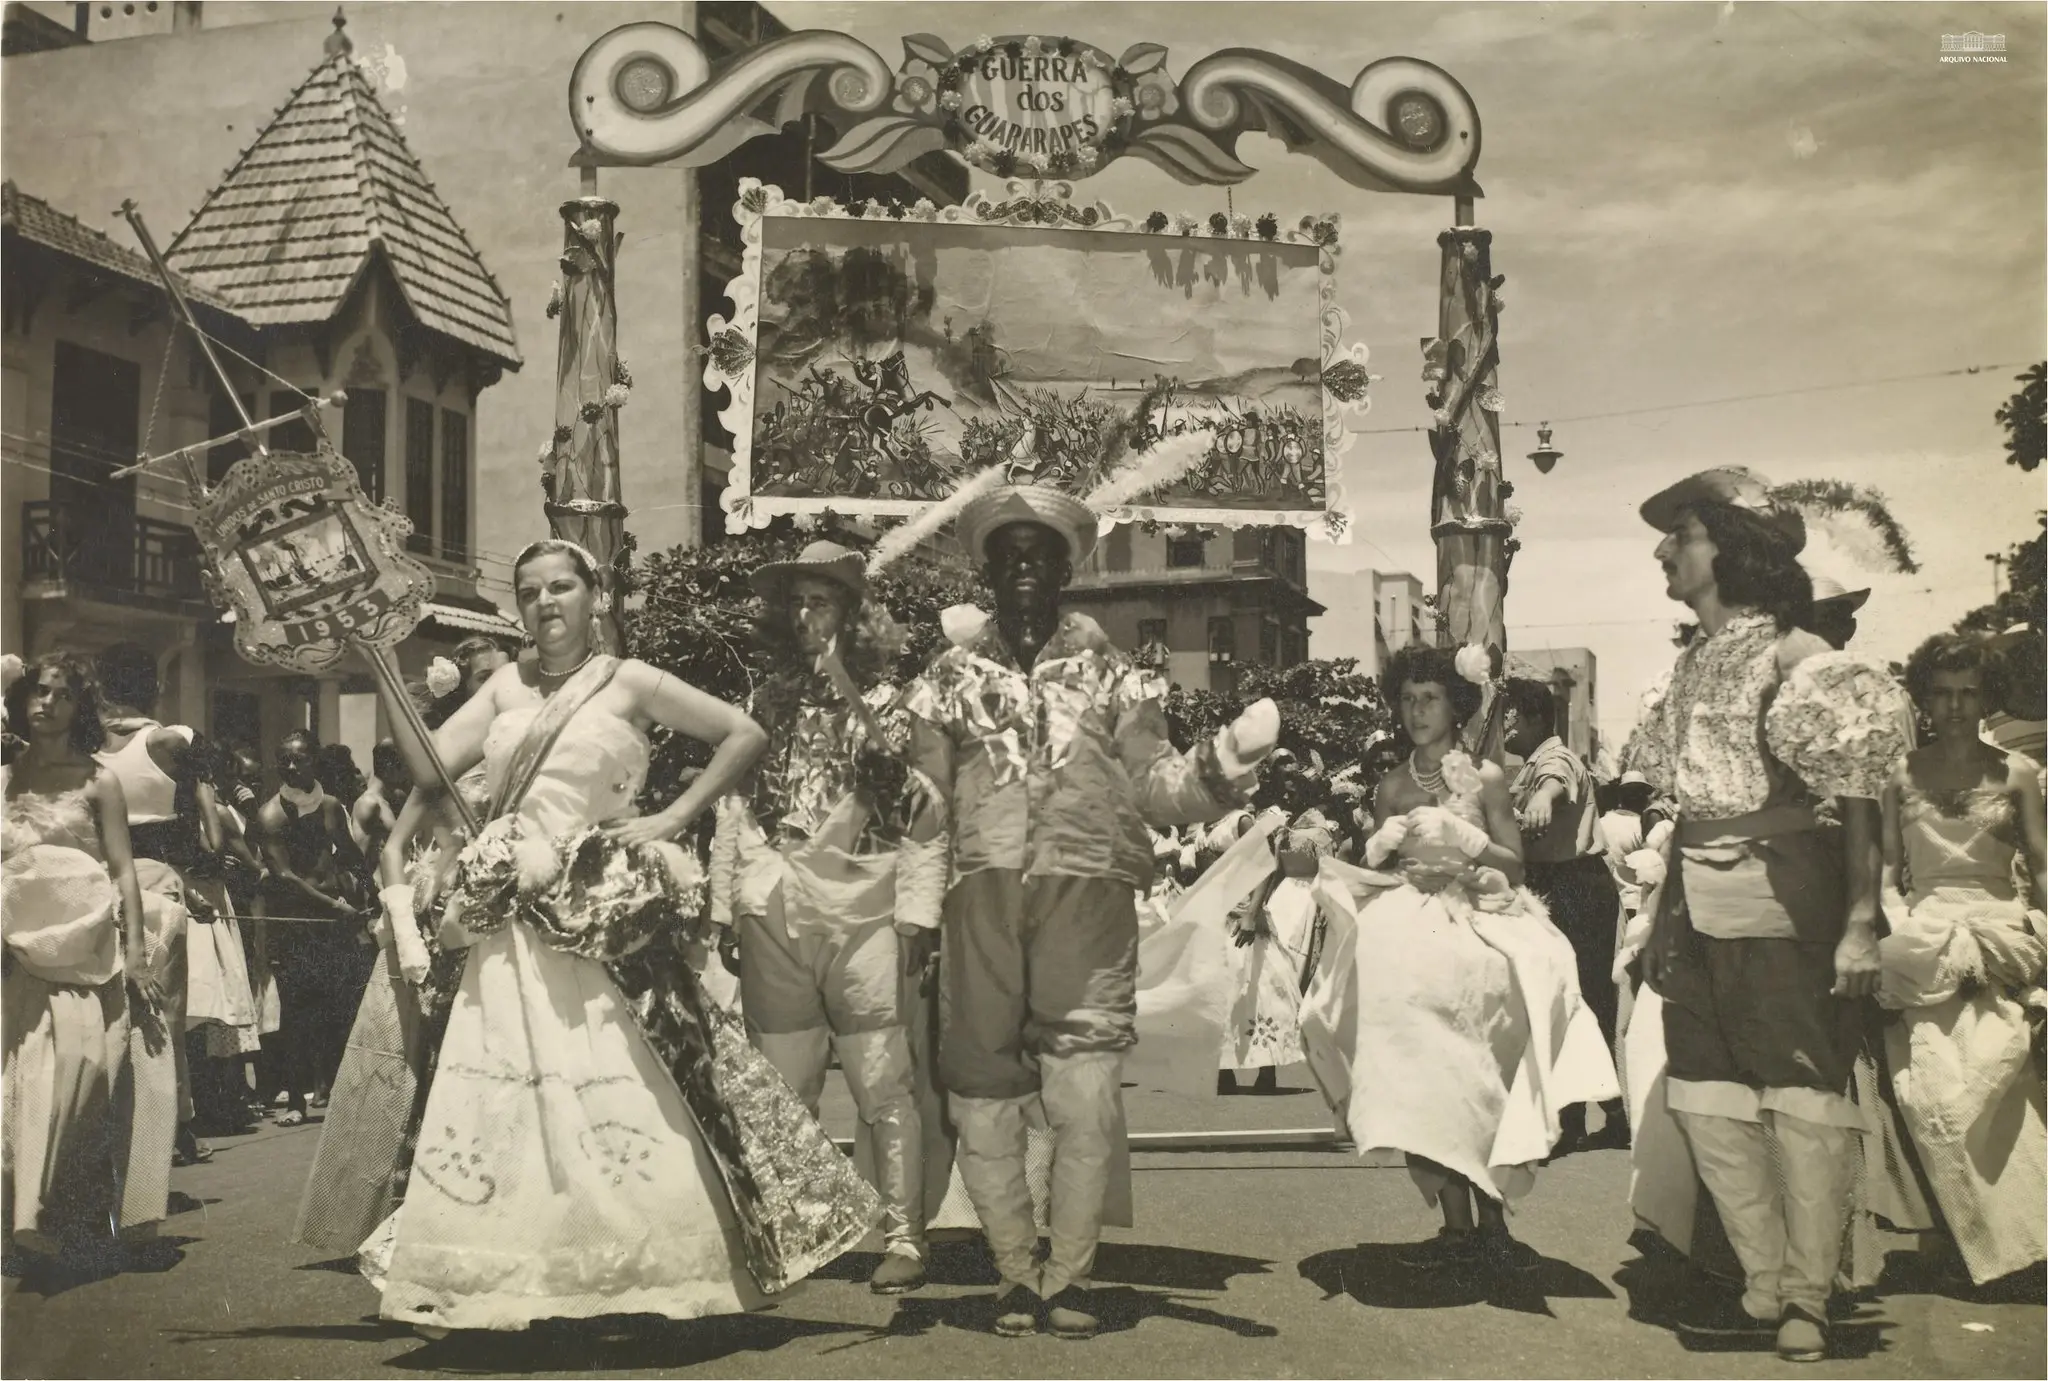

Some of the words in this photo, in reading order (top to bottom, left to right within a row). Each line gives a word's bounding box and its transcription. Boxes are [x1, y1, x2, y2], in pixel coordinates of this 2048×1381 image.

[981, 54, 1088, 83] GUERRA
[1017, 84, 1064, 112] dos
[964, 105, 1099, 153] GUARARAPES
[215, 506, 246, 537] UNIDOS
[257, 484, 286, 504] SANTO
[288, 476, 324, 493] CRISTO
[298, 599, 380, 642] 1953
